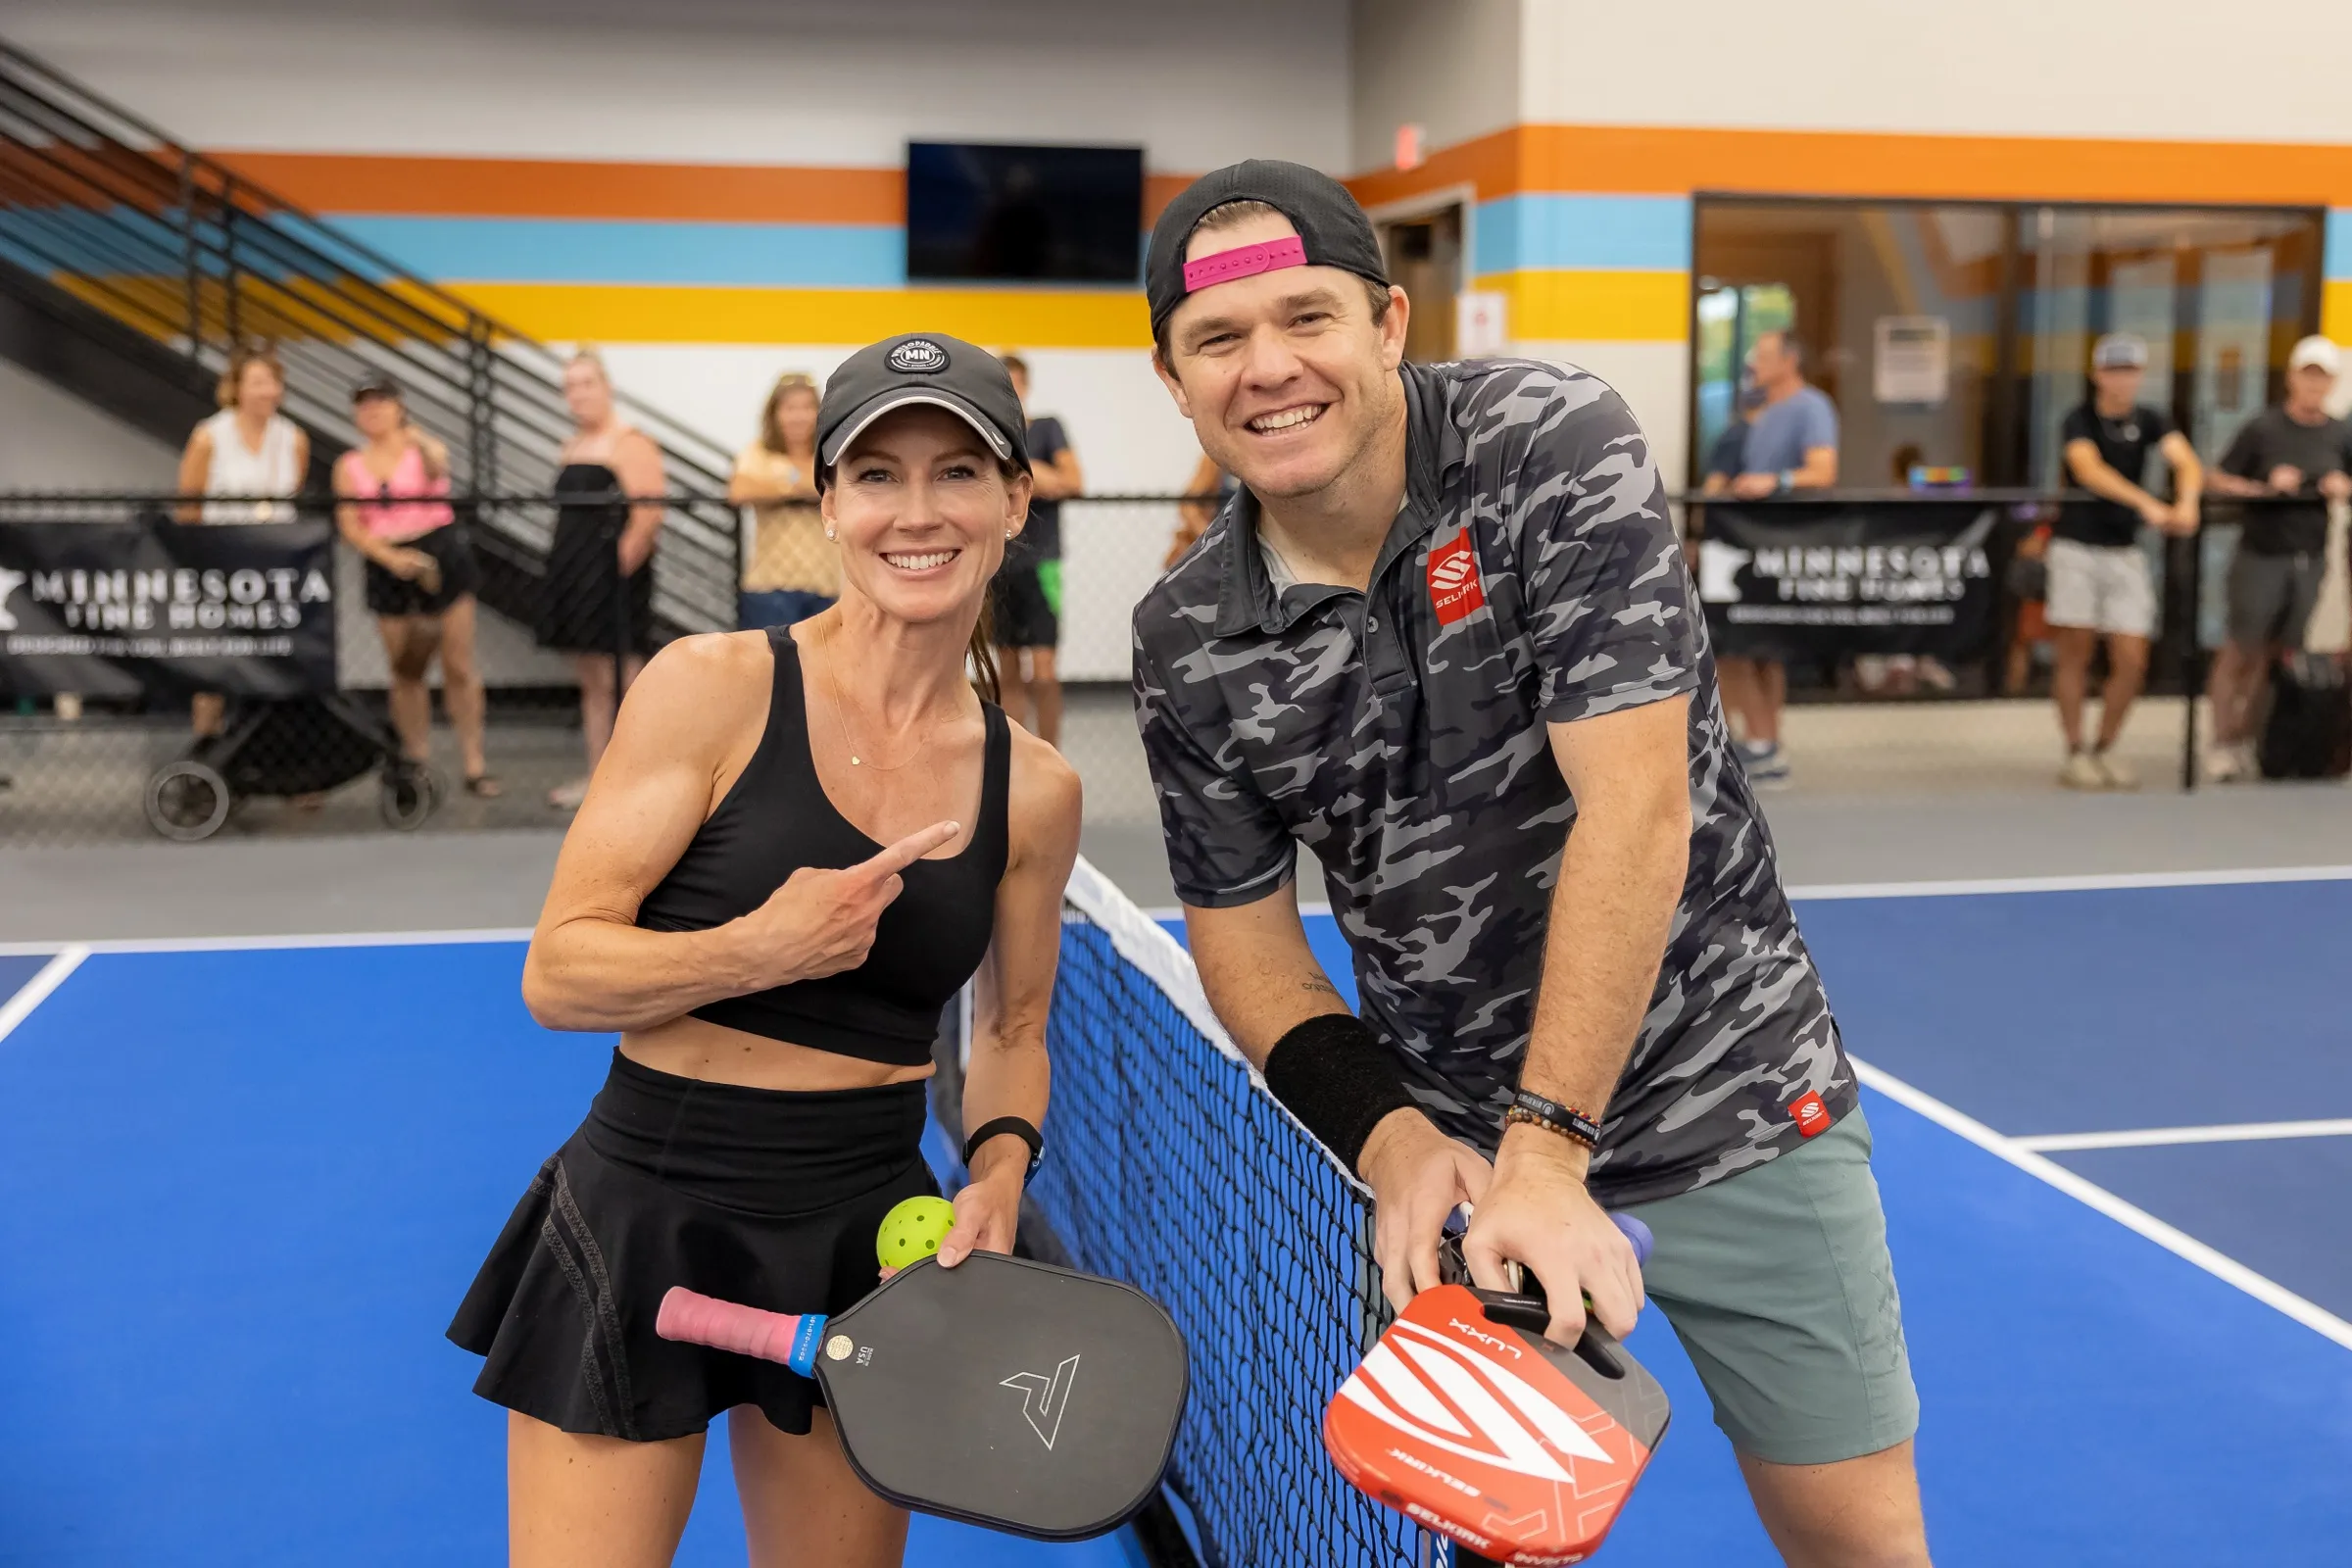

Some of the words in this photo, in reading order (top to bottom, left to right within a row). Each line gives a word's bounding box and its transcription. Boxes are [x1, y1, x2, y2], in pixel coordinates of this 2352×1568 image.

[905, 349, 931, 361] MN
[1752, 545, 1990, 580] MINNESOTA
[32, 567, 331, 605] MINNESOTA
[1435, 579, 1478, 609] SELRK
[856, 1347, 868, 1363] USA
[1448, 1317, 1522, 1360] LUXX
[1389, 1447, 1482, 1497] SELKIRK
